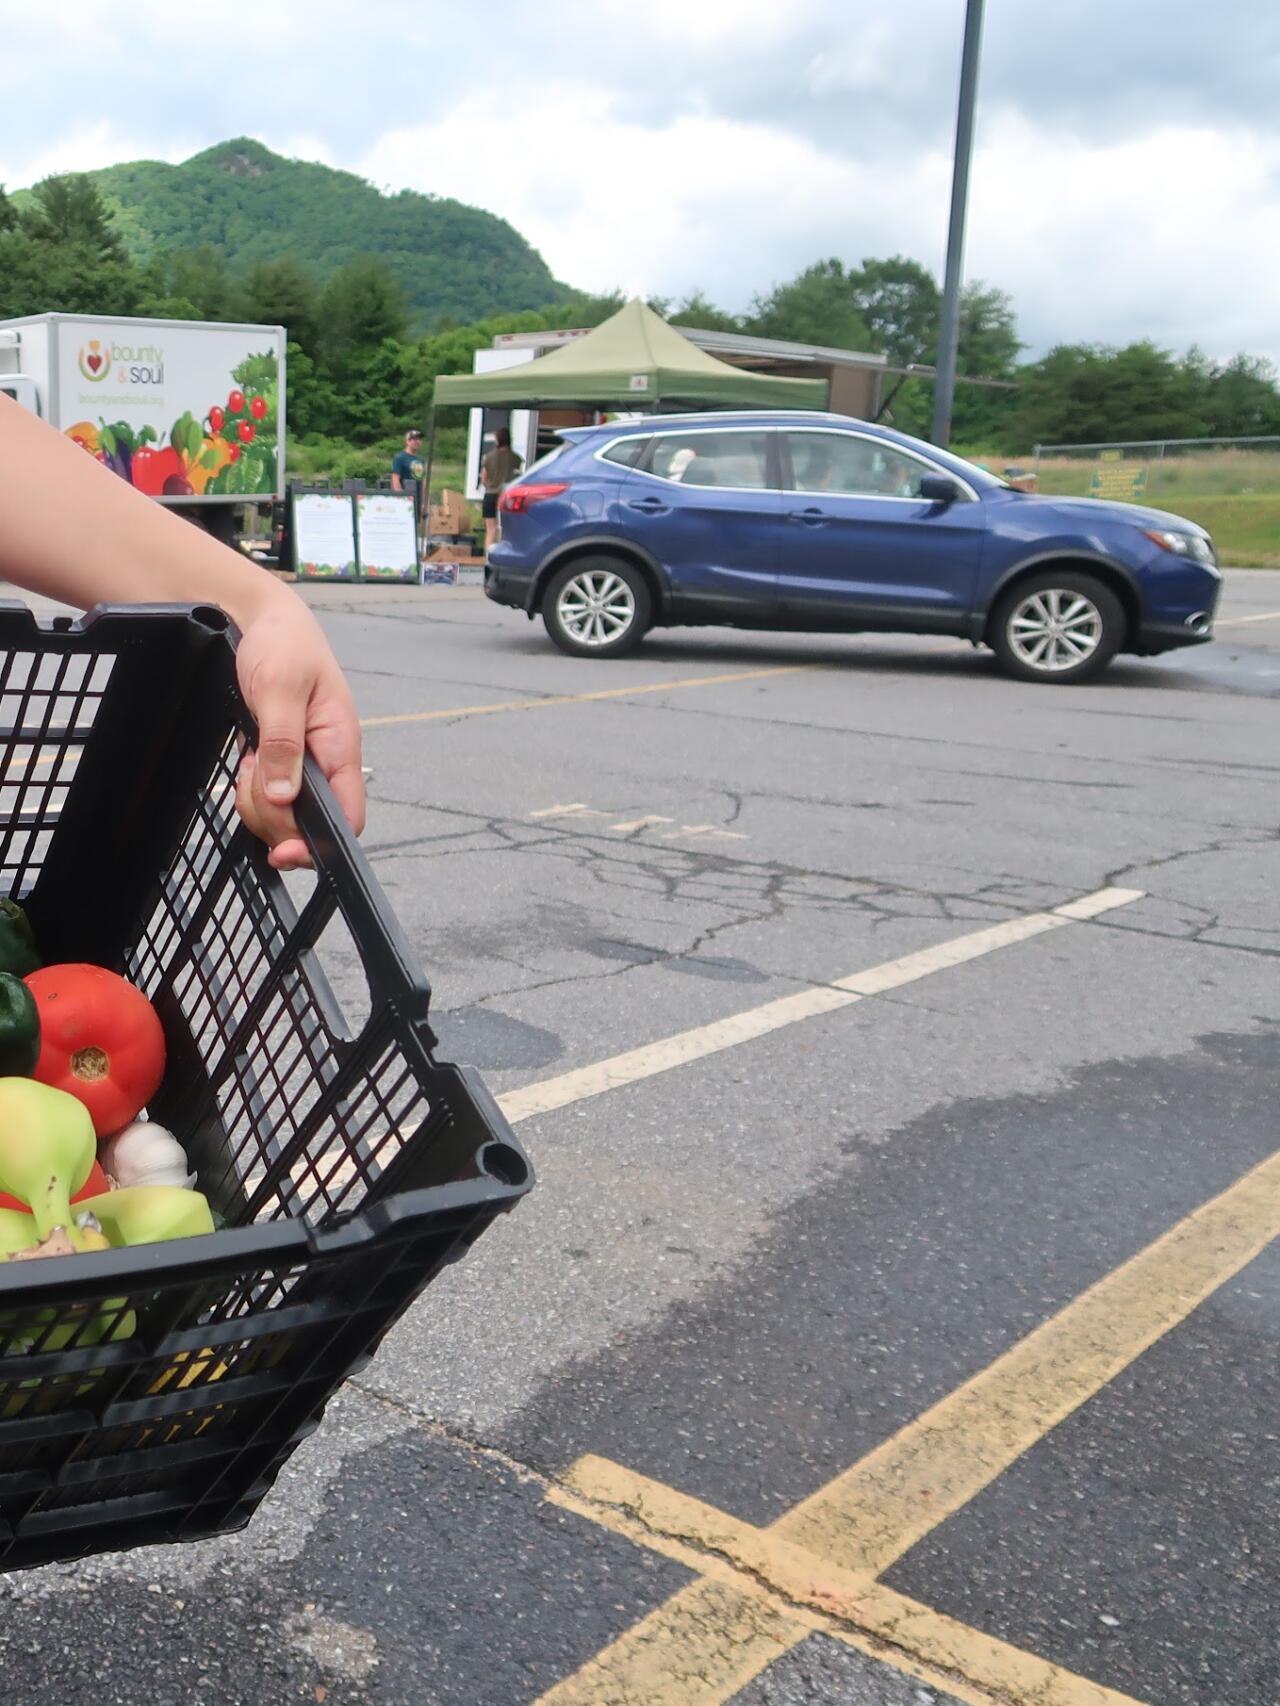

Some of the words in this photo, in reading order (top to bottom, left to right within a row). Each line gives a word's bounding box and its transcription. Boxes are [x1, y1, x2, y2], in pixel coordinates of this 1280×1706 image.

[112, 341, 164, 365] bounty
[118, 367, 128, 384] &
[130, 363, 164, 384] soul
